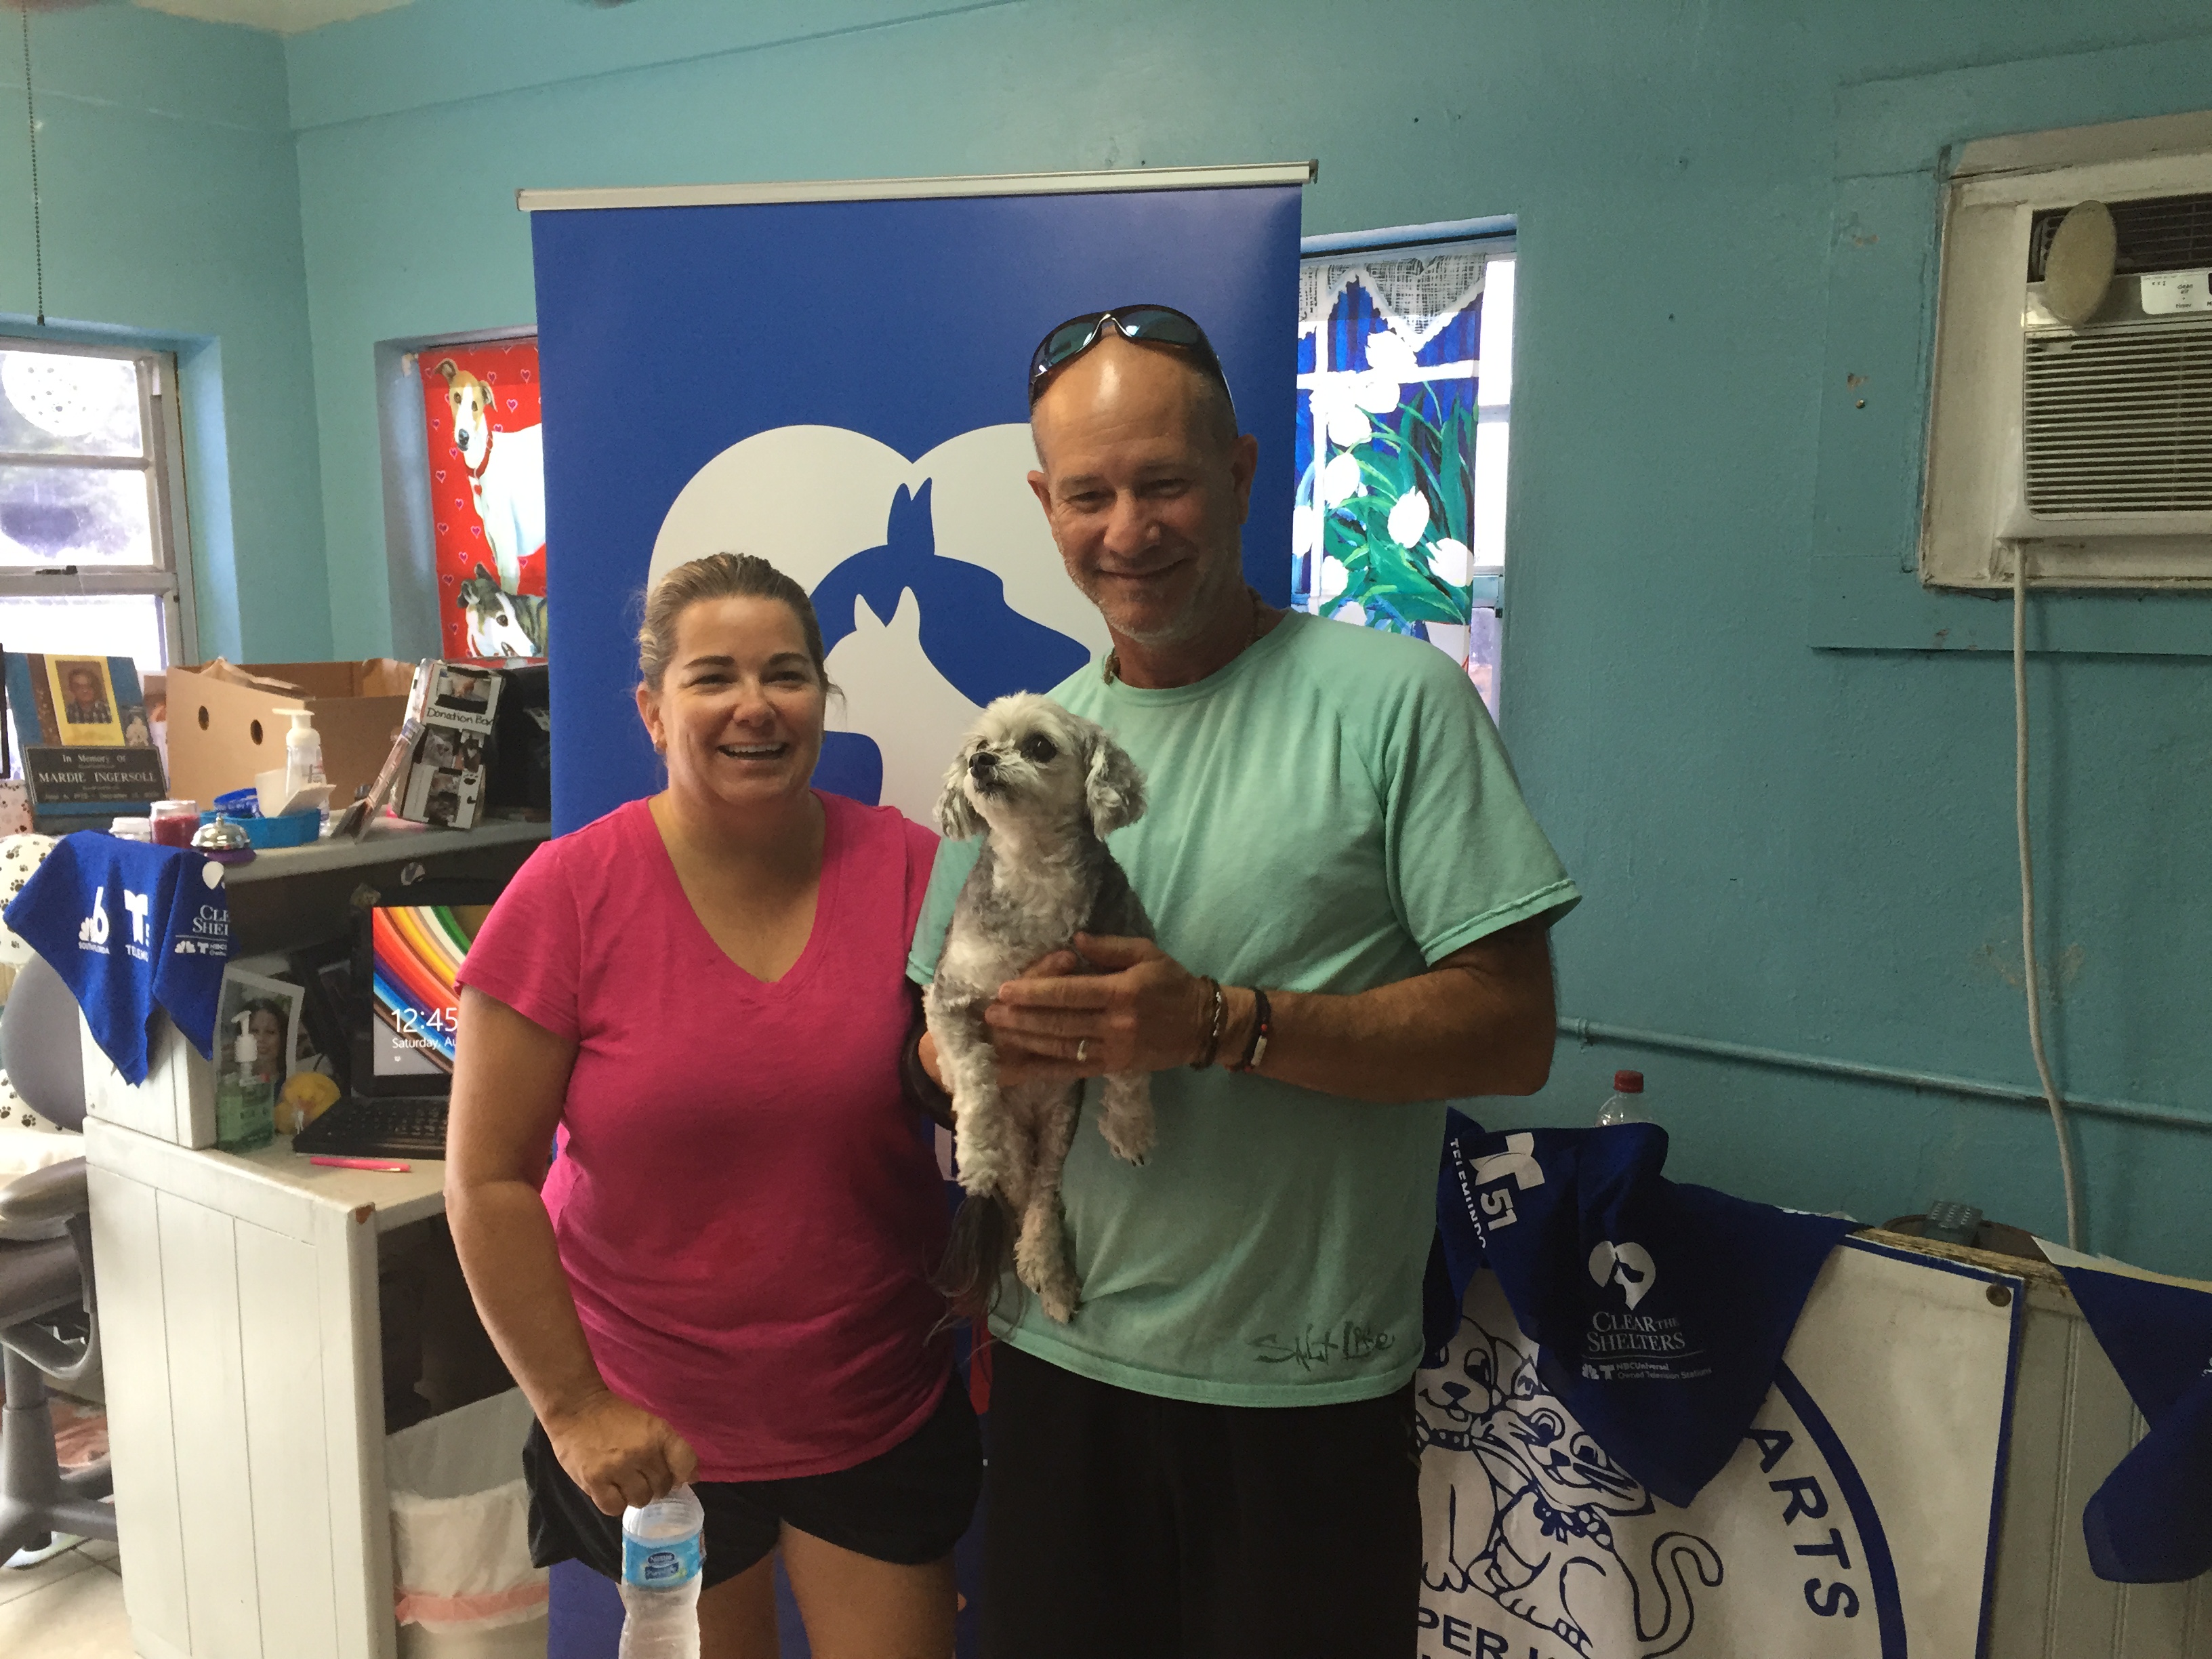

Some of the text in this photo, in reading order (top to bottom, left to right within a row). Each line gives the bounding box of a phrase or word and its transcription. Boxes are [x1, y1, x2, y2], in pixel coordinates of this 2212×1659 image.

[426, 706, 473, 724] Donation
[62, 754, 72, 763] In
[77, 754, 110, 764] Memory
[38, 772, 87, 783] MARDIE
[391, 1007, 459, 1033] 12:45
[392, 1037, 441, 1050] Saturday,
[1480, 1187, 1518, 1231] 51
[1593, 1311, 1657, 1332] CLEAR
[1586, 1331, 1686, 1352] SHELTERS
